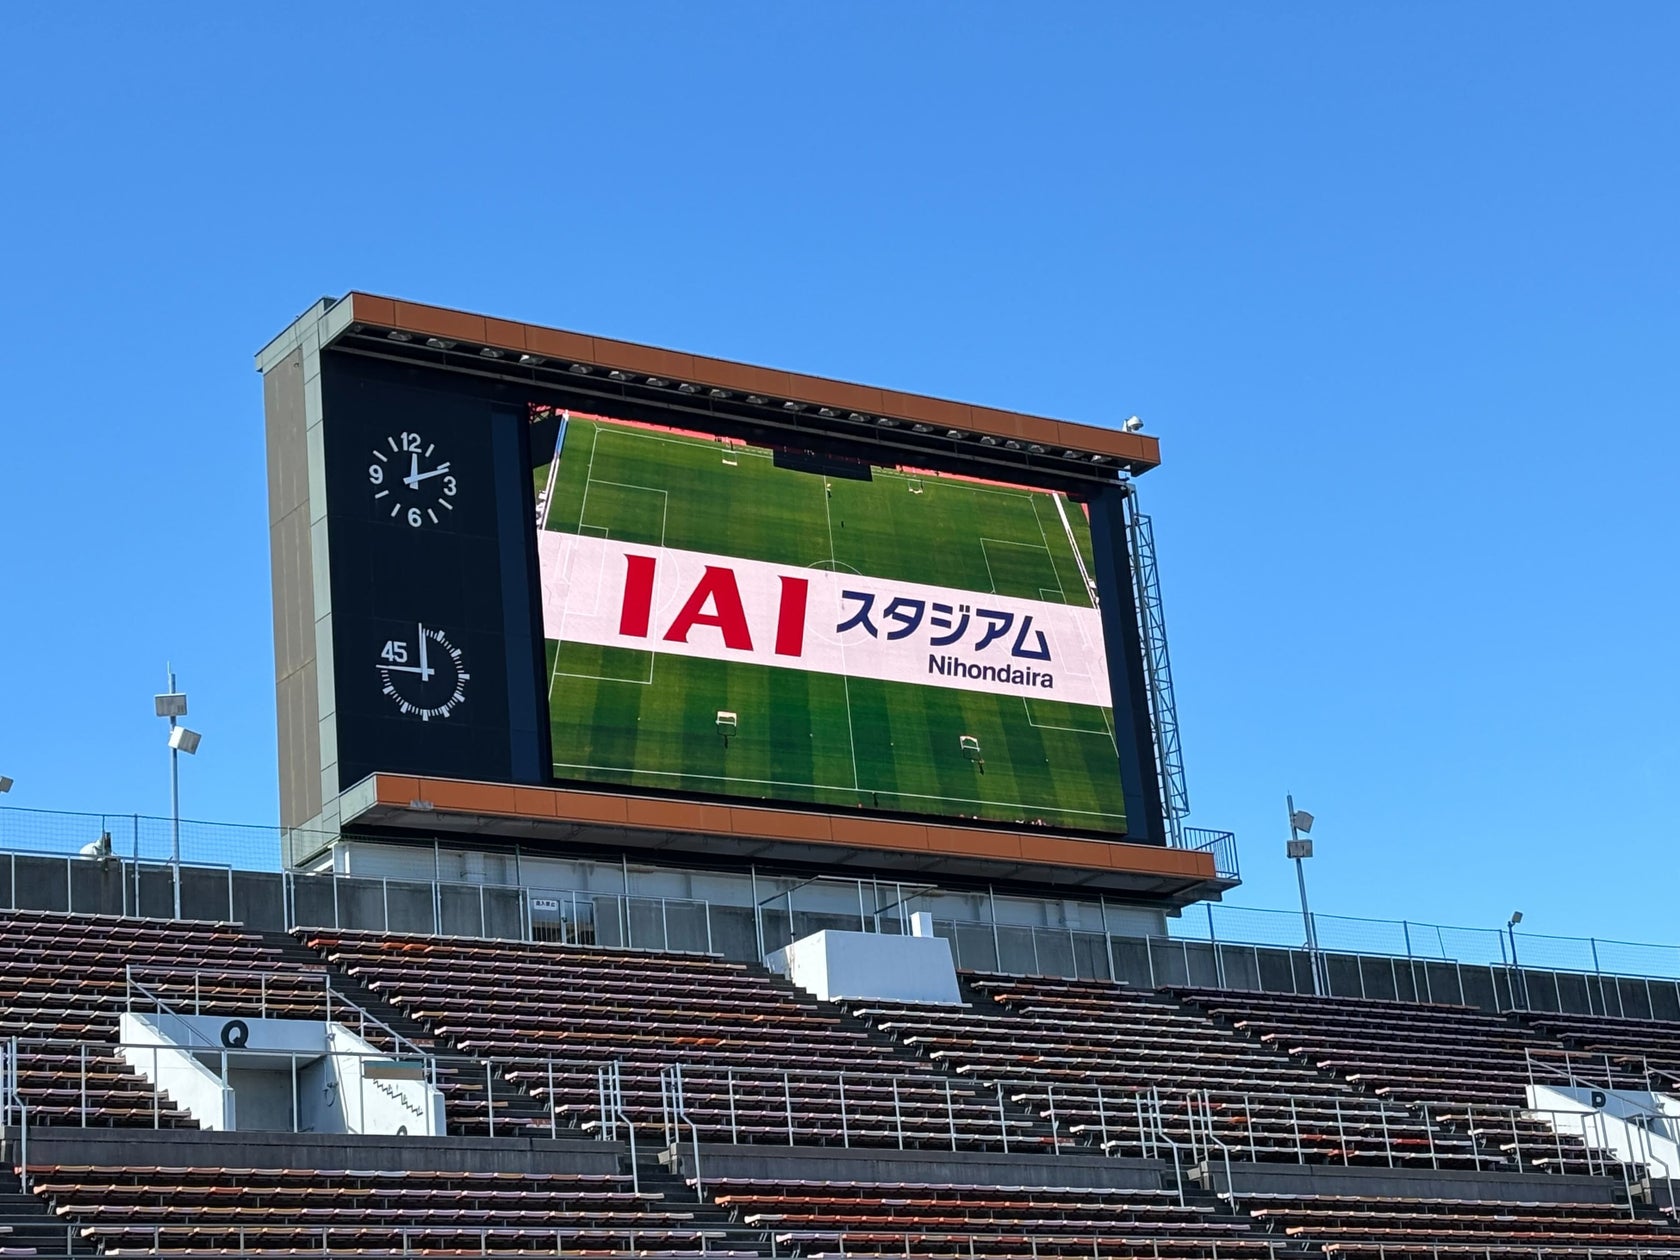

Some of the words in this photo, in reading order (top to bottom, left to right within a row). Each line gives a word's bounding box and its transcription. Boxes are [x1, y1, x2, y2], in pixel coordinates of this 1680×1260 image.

[401, 432, 422, 453] 12
[369, 464, 384, 485] 9
[443, 475, 457, 496] 3
[407, 507, 422, 527] 6
[619, 553, 808, 657] IAI
[836, 590, 1052, 661] スタジアム
[381, 640, 408, 663] 45
[928, 653, 1054, 689] Nihondaira
[220, 1019, 249, 1049] Q
